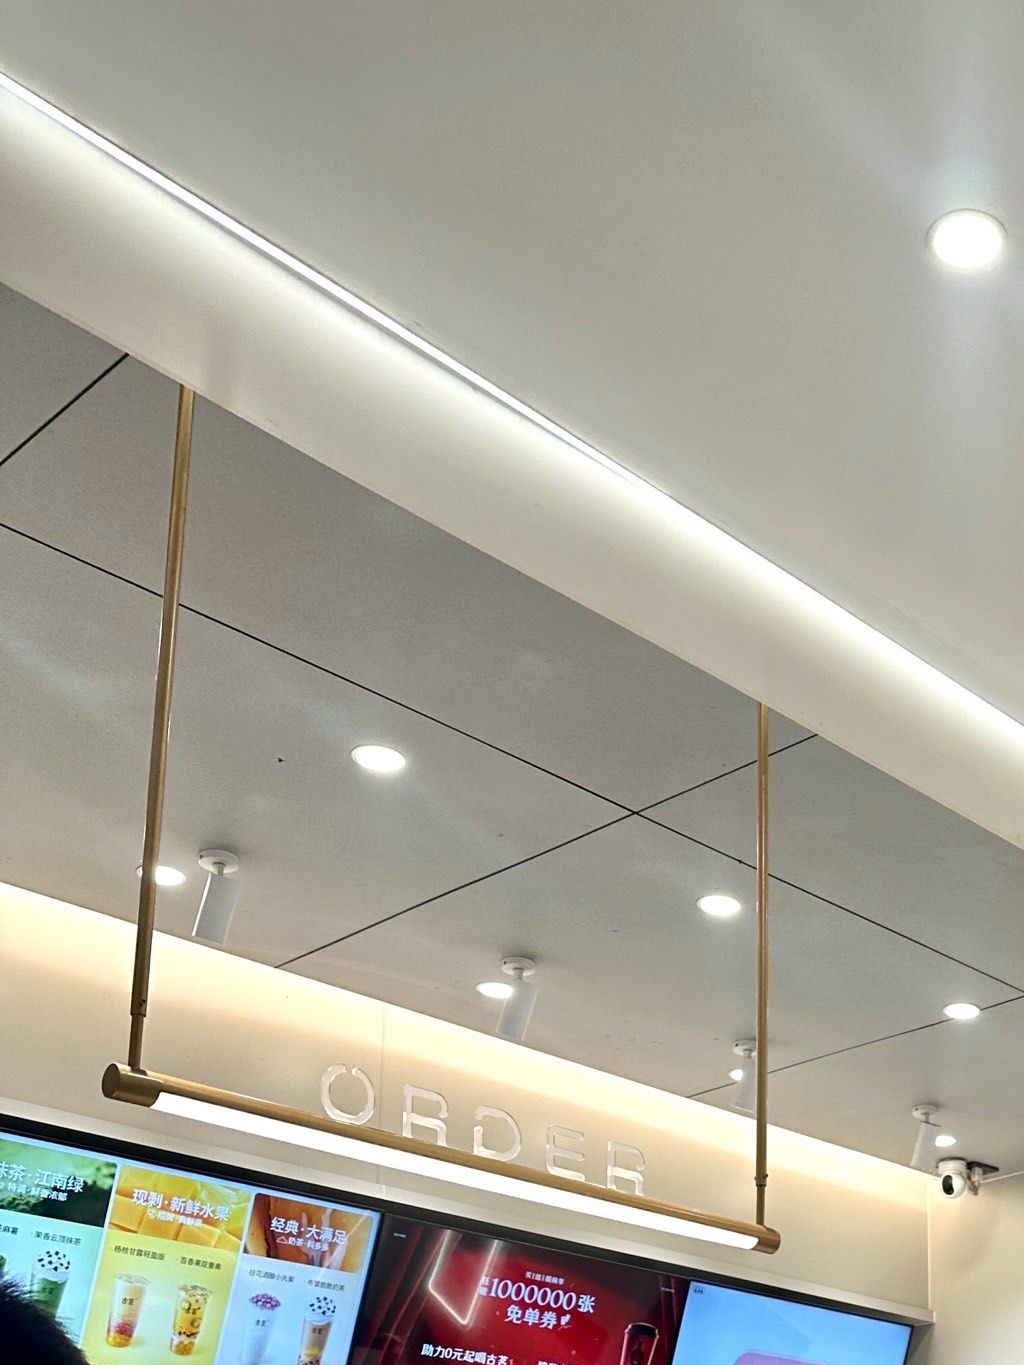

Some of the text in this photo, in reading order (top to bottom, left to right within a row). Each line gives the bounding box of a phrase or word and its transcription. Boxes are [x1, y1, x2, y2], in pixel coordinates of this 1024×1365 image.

[320, 1063, 646, 1197] ORDER
[132, 1188, 230, 1221] 现剥·新鲜水果
[269, 1216, 348, 1245] 经典·大满足
[504, 1304, 558, 1330] 免单券
